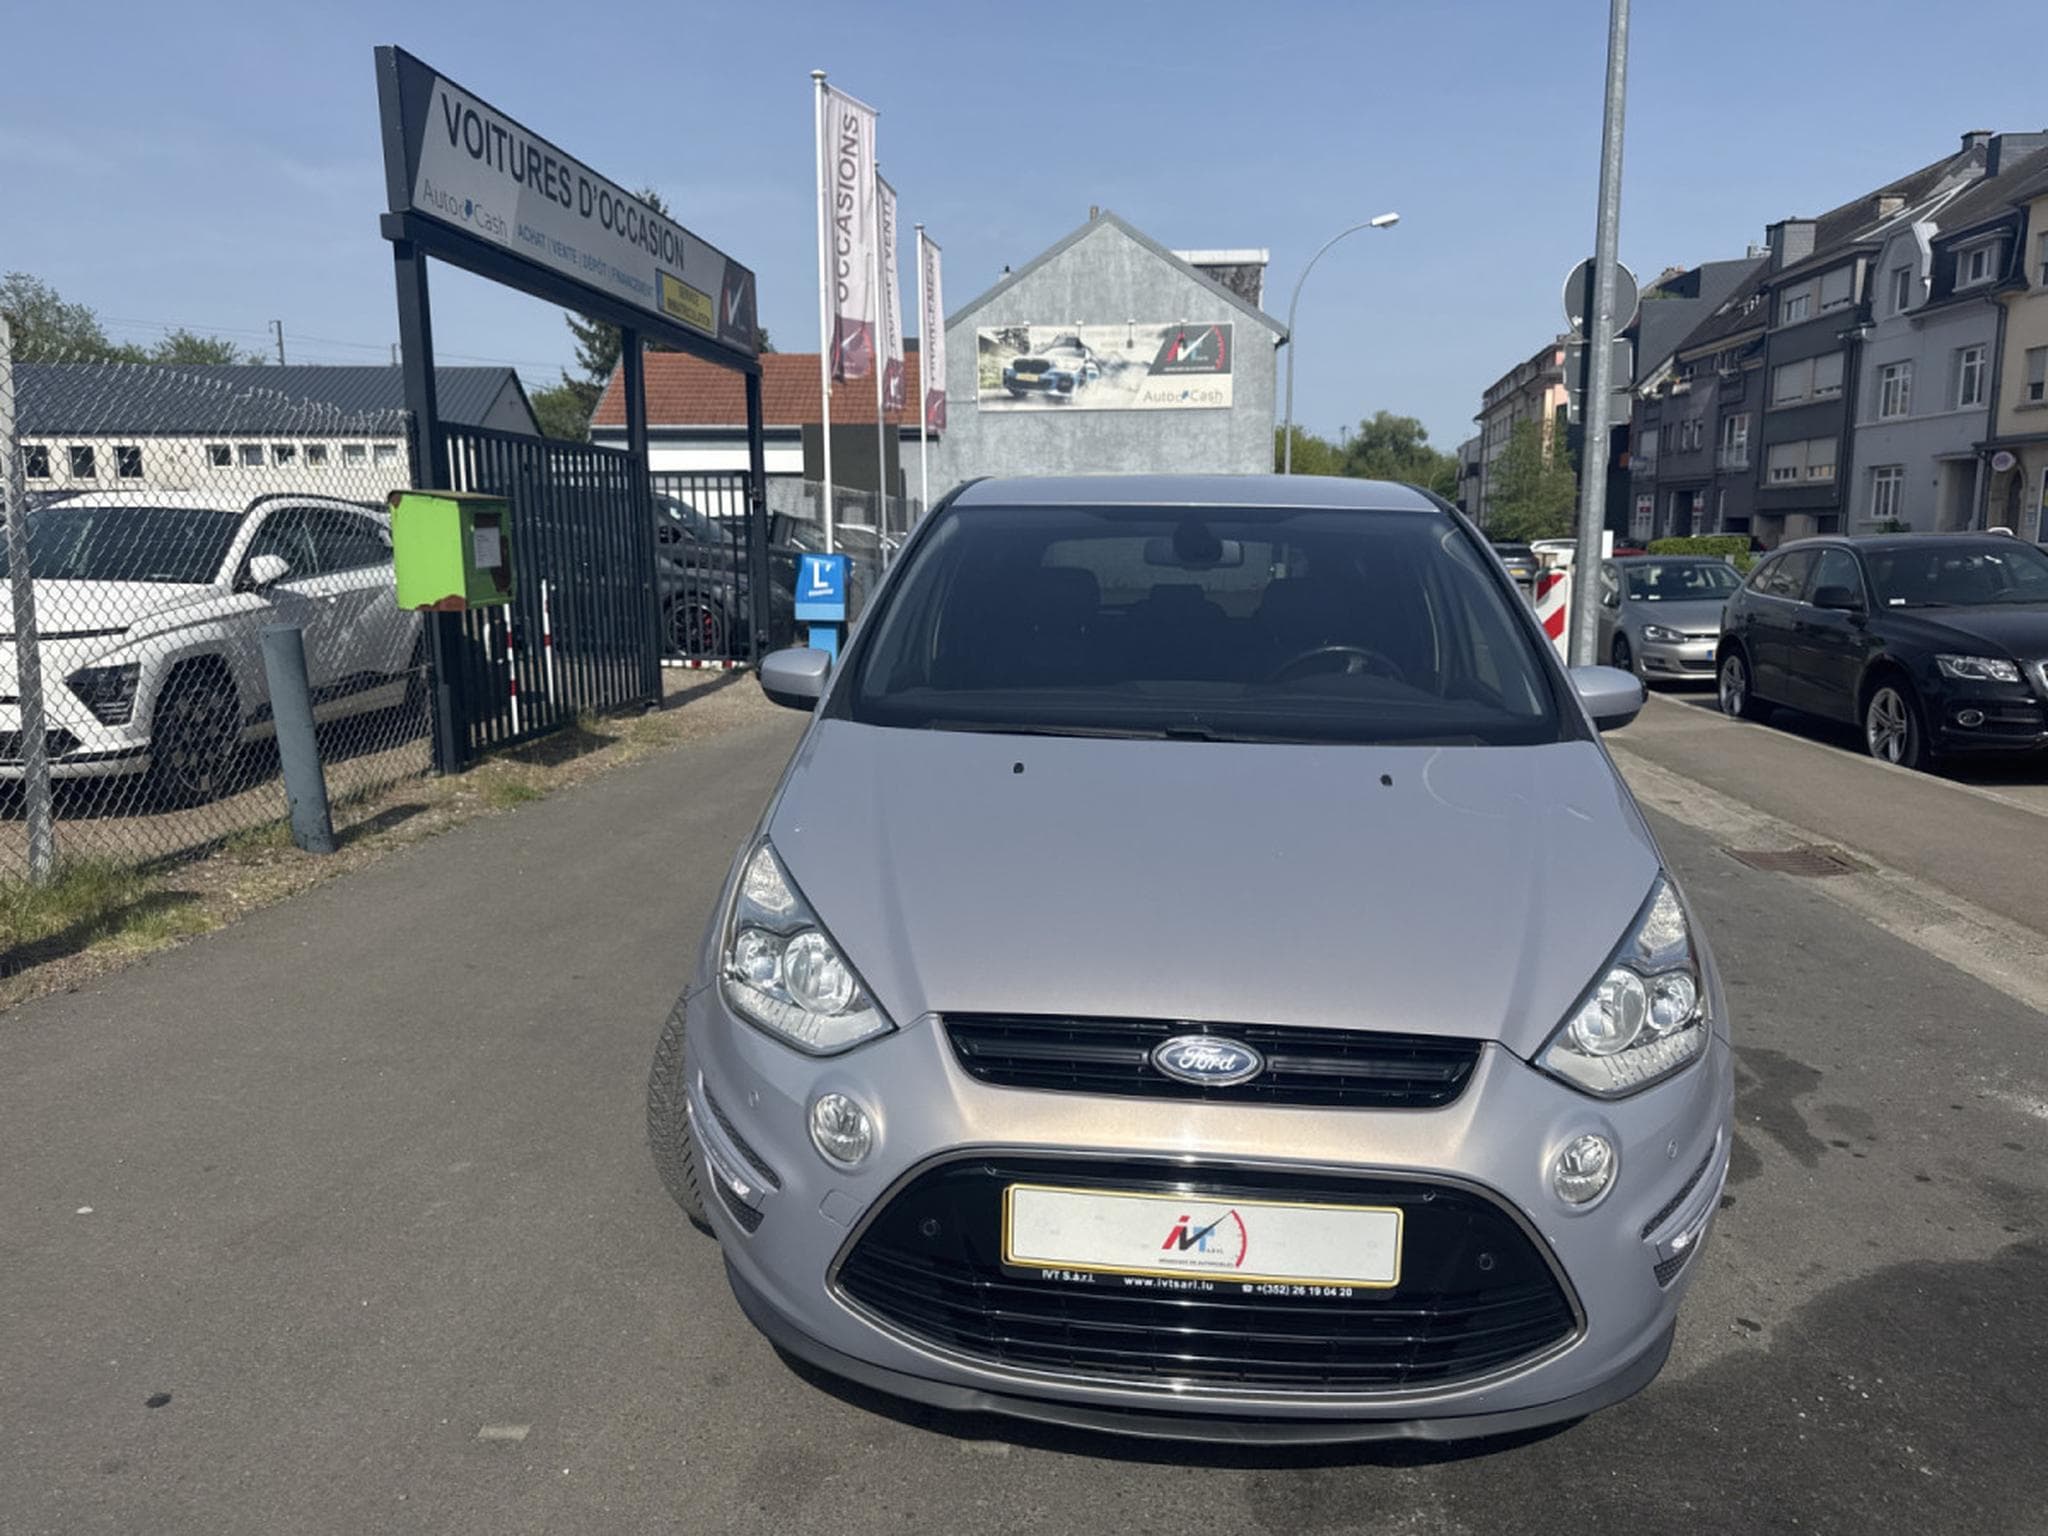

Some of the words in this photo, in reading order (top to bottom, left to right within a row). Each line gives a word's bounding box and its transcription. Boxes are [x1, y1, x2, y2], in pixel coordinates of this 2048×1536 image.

[441, 93, 572, 209] VOITURES
[579, 175, 684, 270] D'OCCASION
[1178, 1045, 1236, 1070] Ford
[1123, 1276, 1215, 1291] www.ivtsarl.lu
[1292, 1286, 1306, 1297] 26
[1309, 1286, 1321, 1297] 19
[1323, 1287, 1337, 1298] 04
[1339, 1287, 1353, 1298] 20
